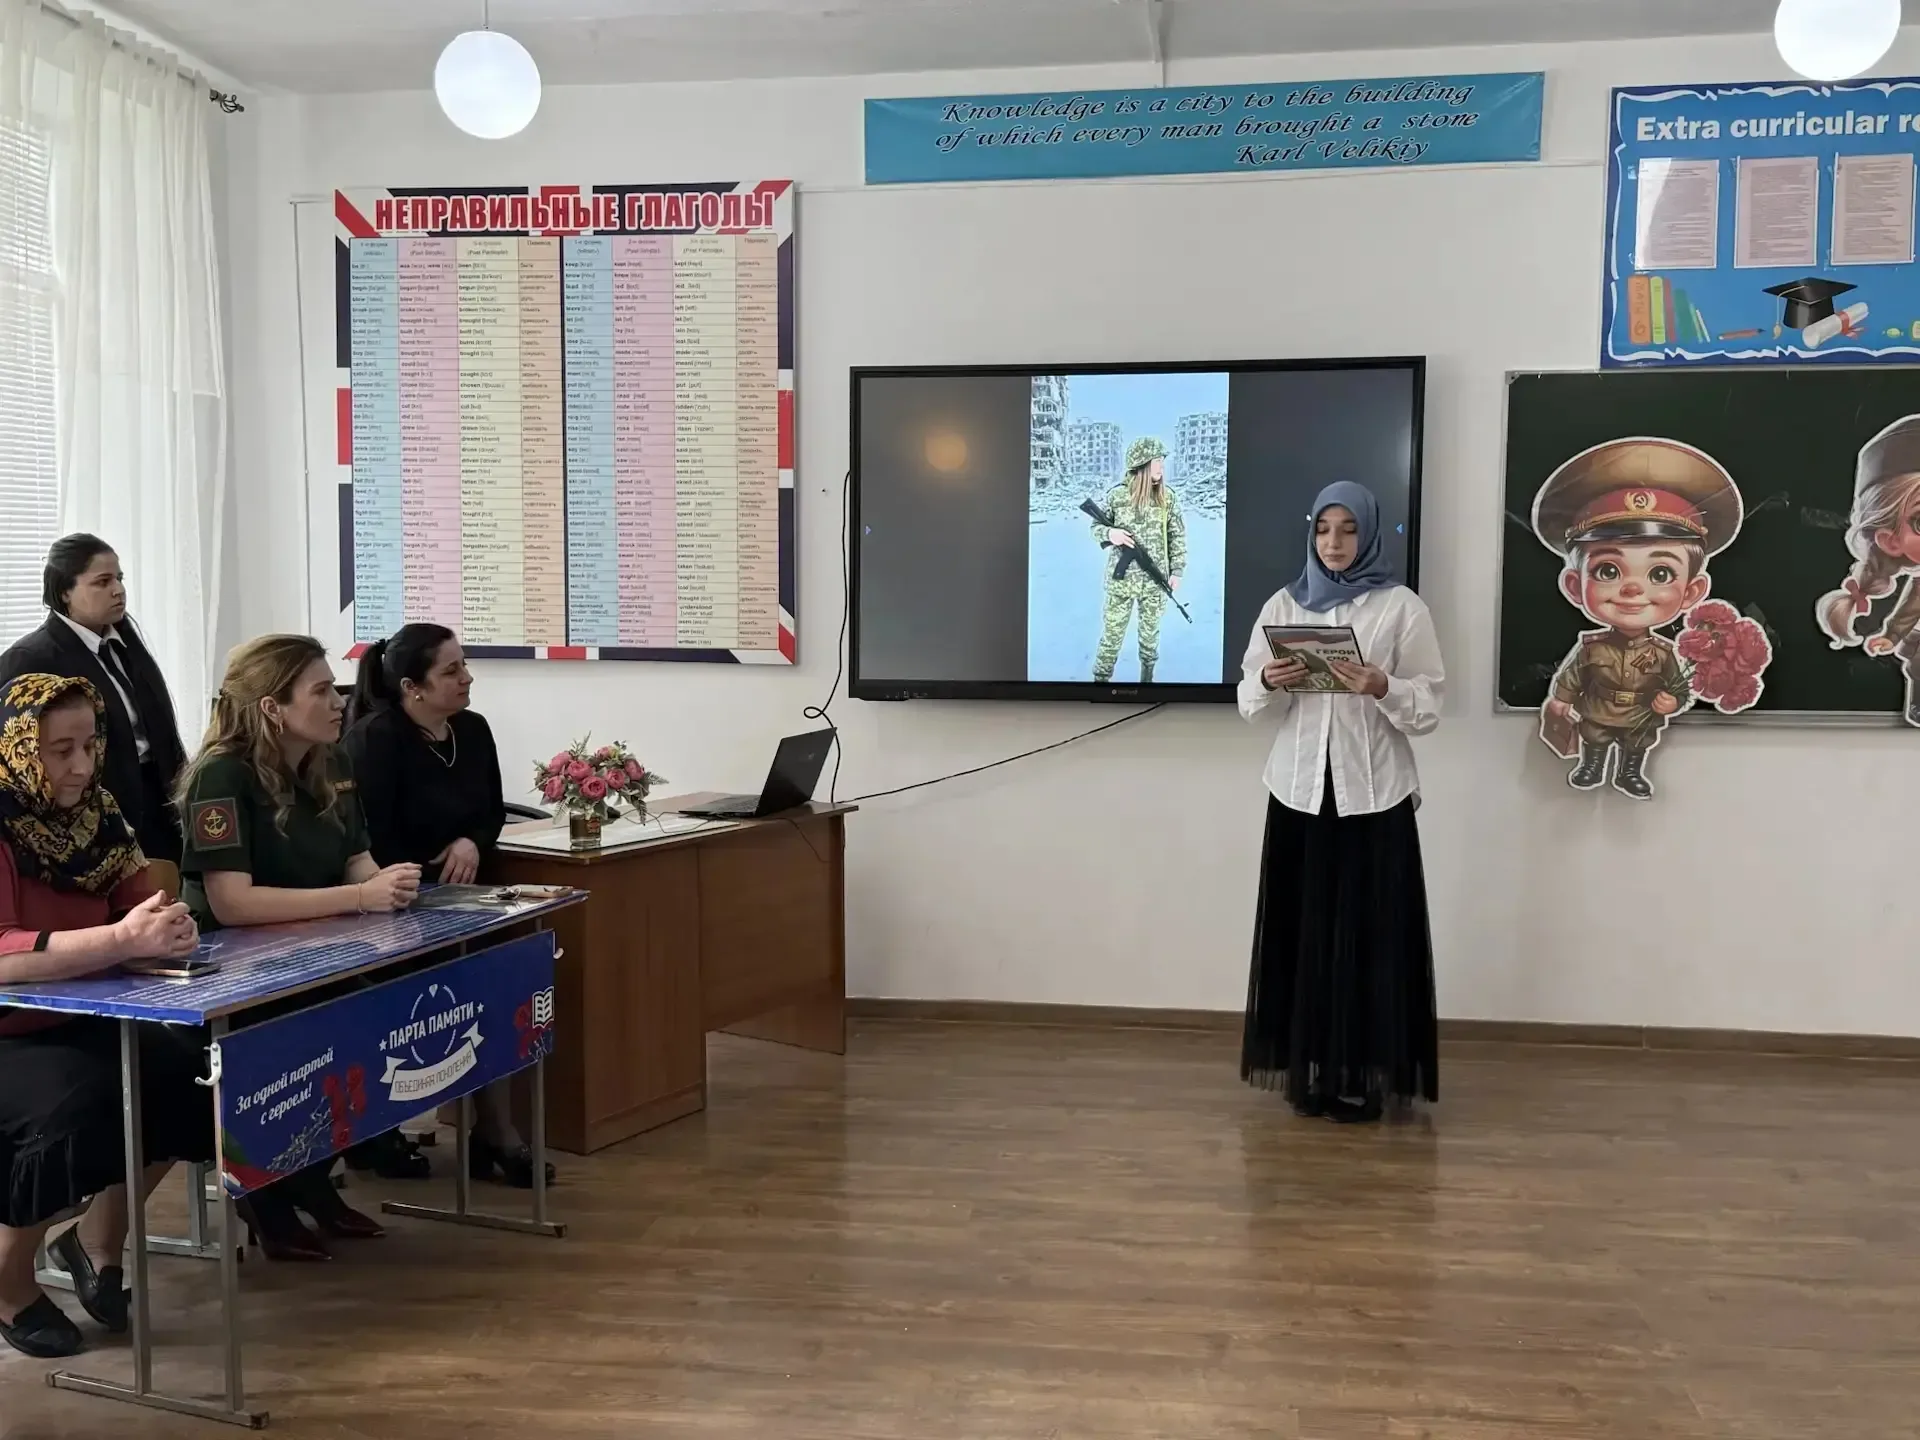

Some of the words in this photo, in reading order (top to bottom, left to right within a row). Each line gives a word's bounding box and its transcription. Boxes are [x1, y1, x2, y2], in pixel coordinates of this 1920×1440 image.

[940, 96, 1105, 124] Knowledge
[1114, 95, 1140, 114] is
[1149, 99, 1166, 113] a
[1175, 92, 1234, 116] city
[1243, 91, 1275, 109] to
[1285, 85, 1334, 107] the
[1344, 80, 1476, 106] building
[935, 127, 974, 153] of
[975, 123, 1066, 148] which
[1072, 126, 1151, 148] every
[1160, 121, 1223, 139] man
[1234, 111, 1353, 139] brought
[1362, 115, 1382, 130] a
[1402, 111, 1480, 130] stone
[1636, 116, 1721, 141] Extra
[1730, 110, 1890, 137] curricular
[1235, 139, 1316, 166] Karl
[1317, 136, 1430, 162] Velikiy
[375, 195, 618, 230] НЕПРАВИЛЬНЫЕ
[626, 193, 774, 229] ГЛАГОЛЫ
[389, 1020, 426, 1050] ПАРТА
[428, 1001, 474, 1034] ПАМЯТИ
[235, 1095, 251, 1115] За
[253, 1071, 288, 1105] одной
[289, 1045, 334, 1084] партой
[394, 1073, 435, 1093] ОБЪЕДИНЯЯ
[436, 1049, 472, 1082] ПОКОЛЕНИЯ
[260, 1111, 267, 1125] с
[268, 1081, 313, 1120] героем!
